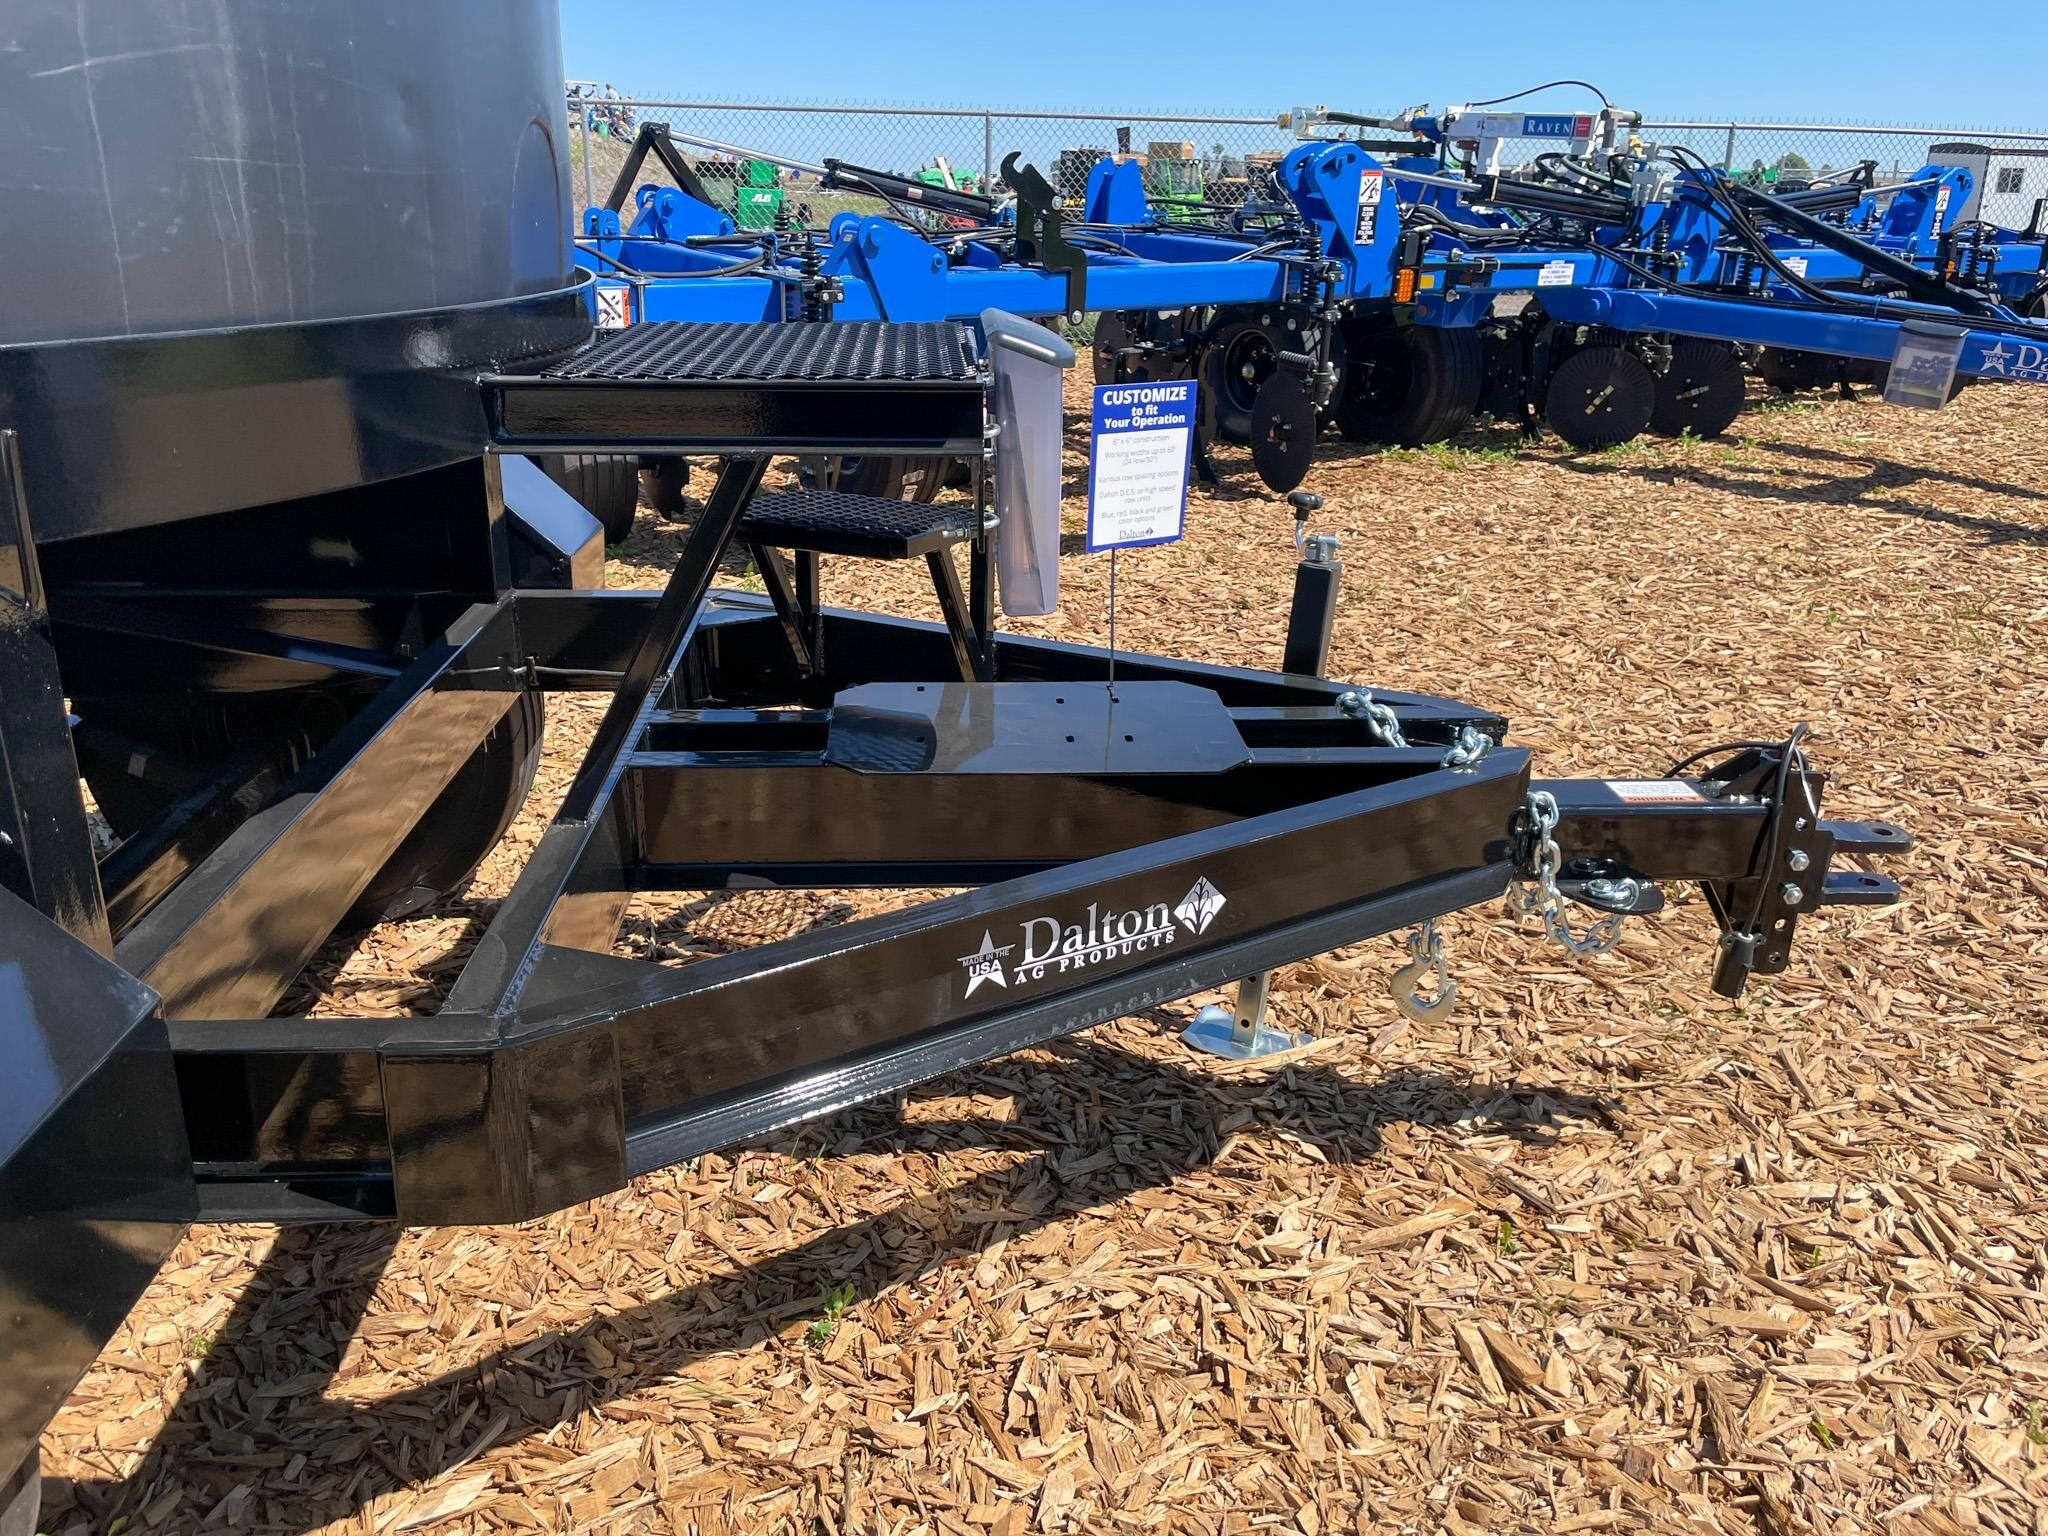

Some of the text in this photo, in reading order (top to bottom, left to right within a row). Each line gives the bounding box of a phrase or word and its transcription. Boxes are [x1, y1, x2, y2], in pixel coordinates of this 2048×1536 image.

[1527, 120, 1571, 133] RAVEN
[1985, 356, 2004, 365] USA
[1103, 386, 1187, 406] CUSTOMIZE
[1131, 404, 1158, 416] to fit
[1104, 413, 1185, 429] Your Operation
[1105, 451, 1129, 459] Working
[1119, 529, 1146, 540] Dalton
[1020, 902, 1172, 965] Dalton
[962, 948, 1010, 967] MADE IN THE
[1014, 930, 1176, 985] AG PRODUCTS
[969, 959, 1002, 978] USA
